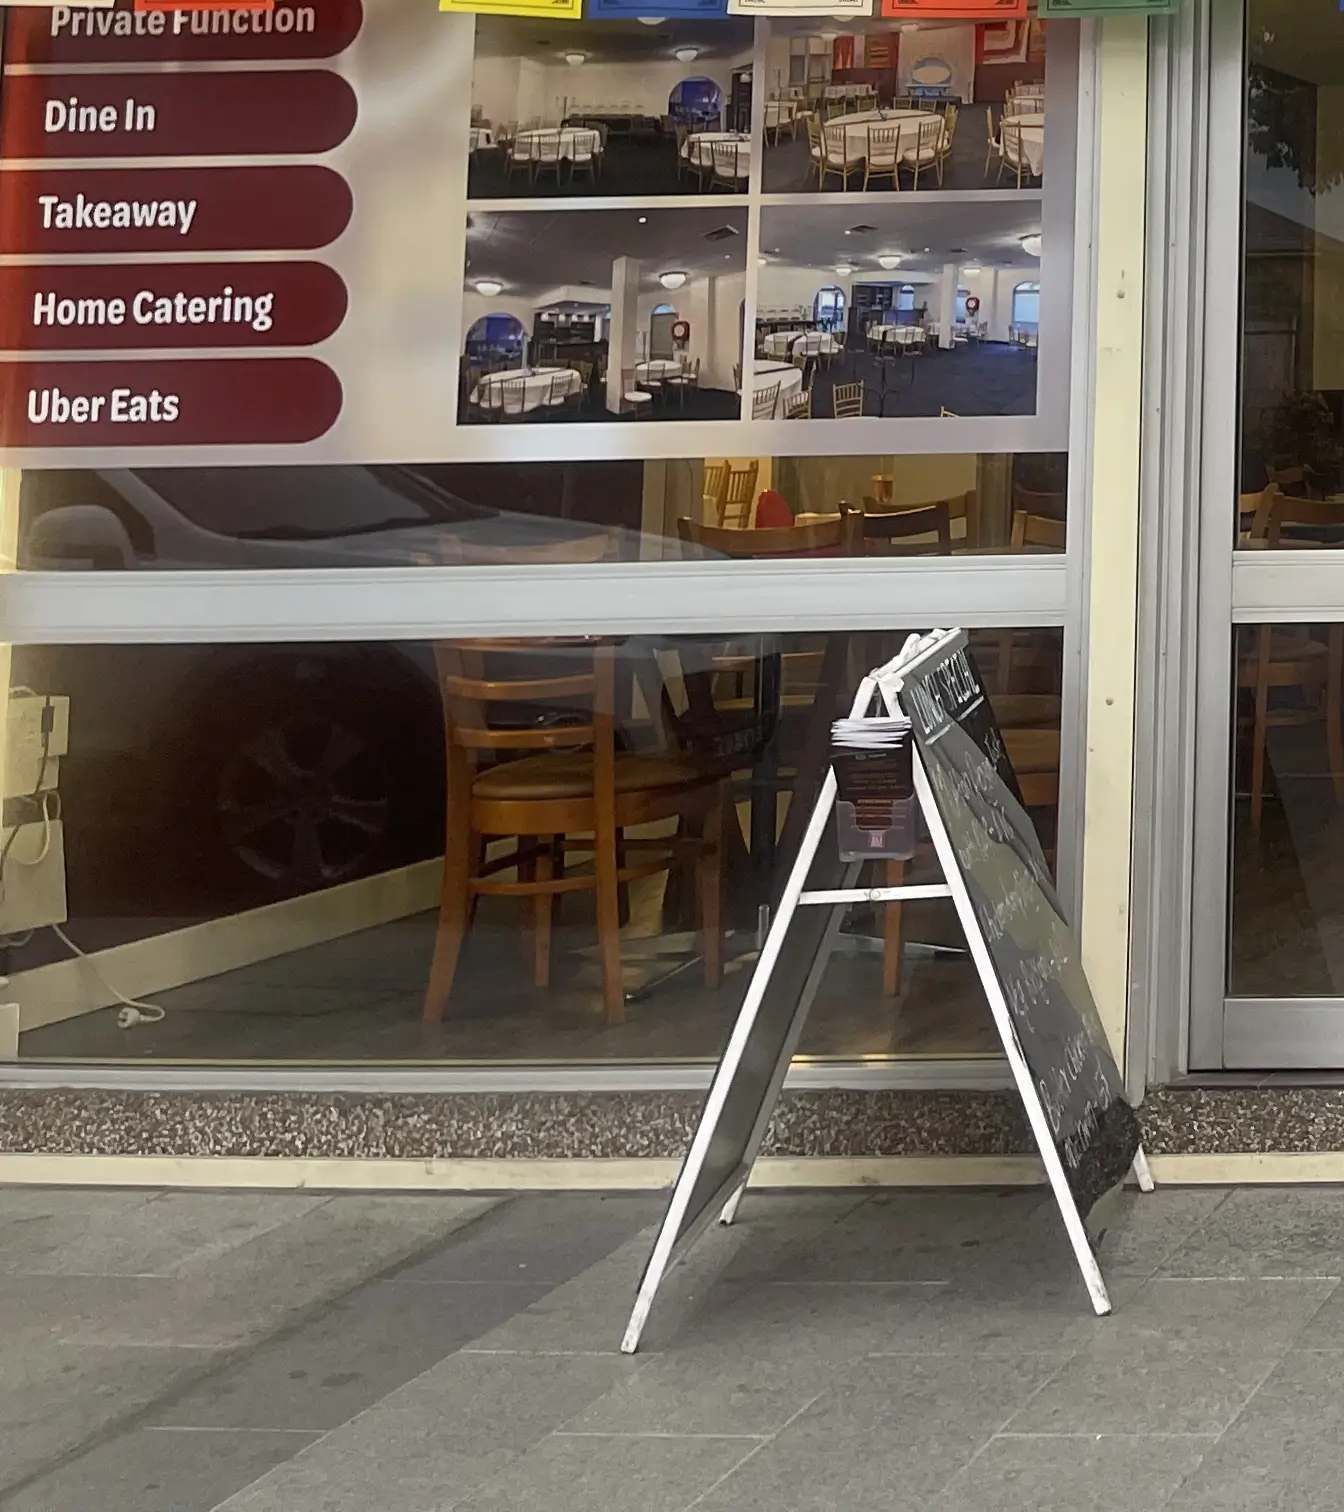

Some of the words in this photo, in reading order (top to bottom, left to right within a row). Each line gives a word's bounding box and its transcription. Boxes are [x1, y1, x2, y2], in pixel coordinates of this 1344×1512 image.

[50, 5, 166, 37] Private
[172, 6, 315, 36] Function
[44, 97, 117, 132] Dine
[124, 98, 156, 131] In
[38, 193, 197, 235] Takeaway
[33, 292, 126, 326] Home
[132, 286, 274, 332] Catering
[28, 388, 105, 423] Uber
[110, 388, 180, 422] Eats
